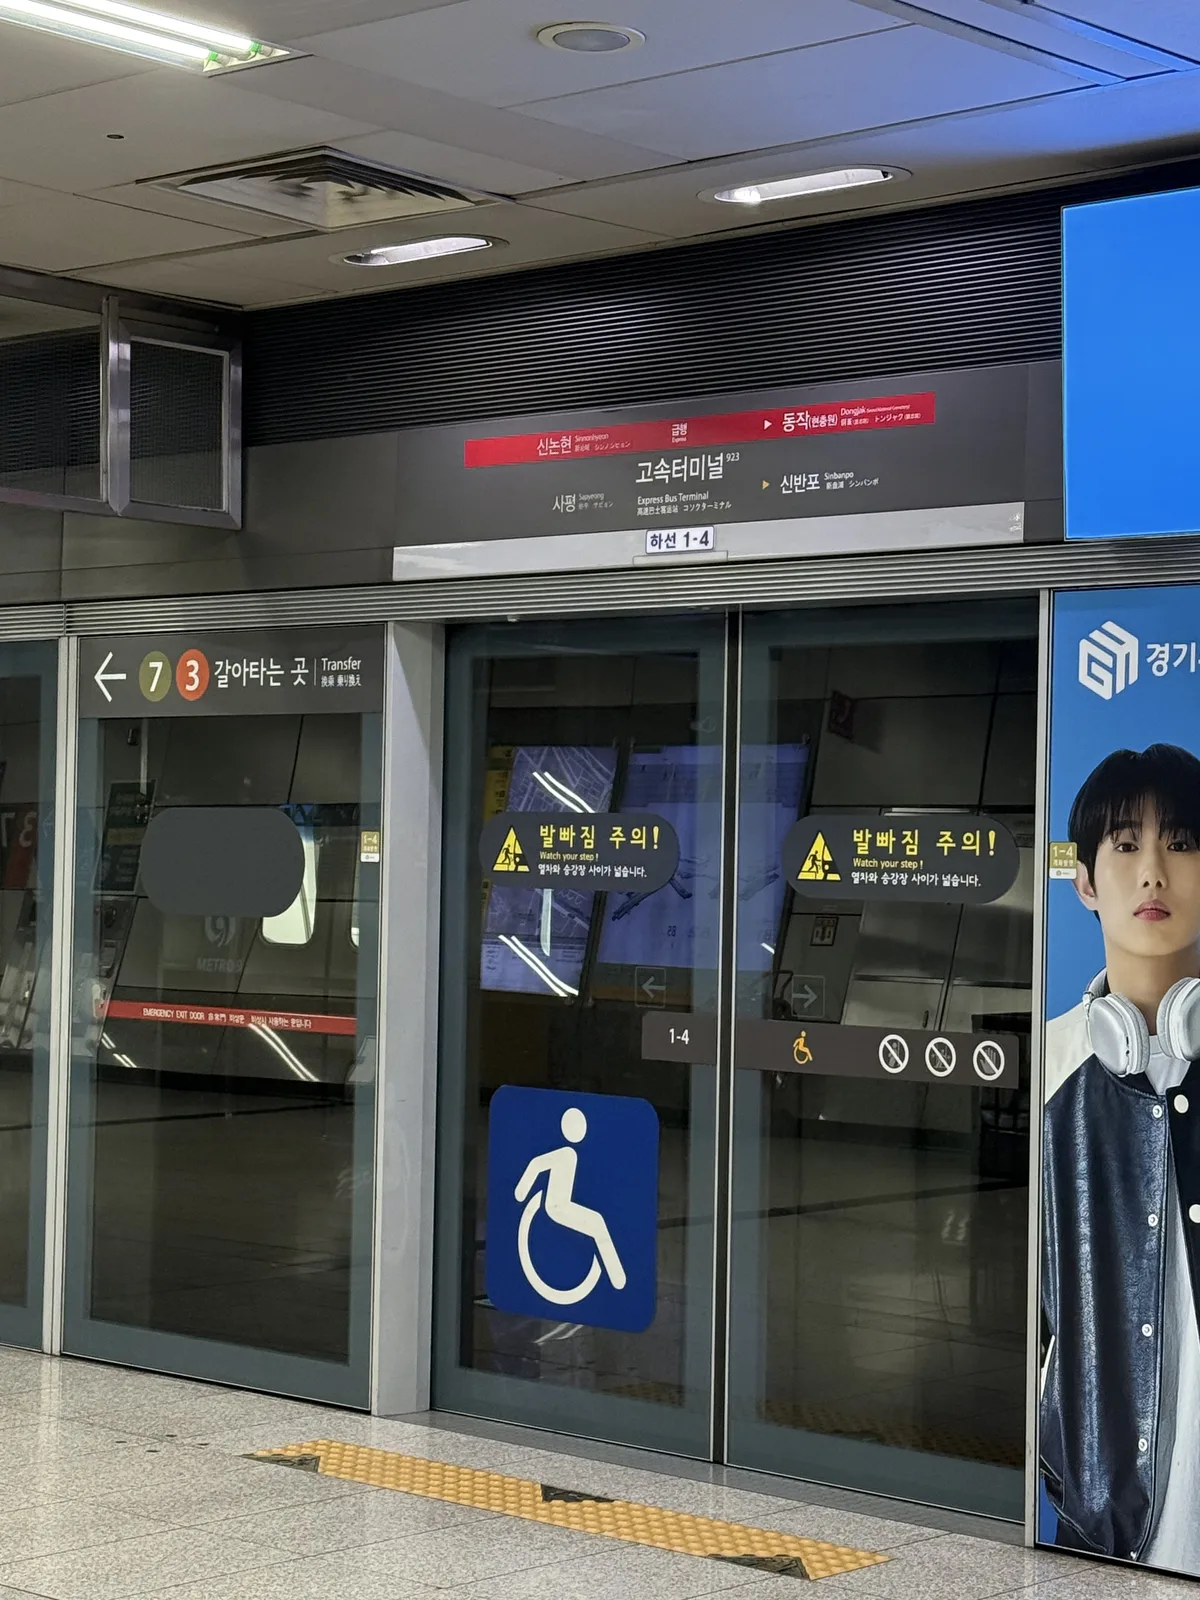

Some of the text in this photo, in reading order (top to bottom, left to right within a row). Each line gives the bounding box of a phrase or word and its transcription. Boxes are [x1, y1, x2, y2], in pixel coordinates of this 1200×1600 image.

[840, 405, 866, 417] Dongjak
[671, 422, 688, 437] 급행
[536, 435, 572, 456] 신논현
[635, 452, 740, 483] 고속터미널 923
[780, 473, 820, 494] 신반포
[823, 471, 855, 481] Sinbanpo
[552, 493, 576, 513] 사평
[579, 492, 605, 502] Sapyeong
[637, 490, 710, 507] Express Bus Terminal
[650, 530, 709, 550] 하선 1-4
[321, 656, 362, 671] Transfer
[1146, 641, 1200, 677] 경기
[149, 657, 309, 692] 7 3 갈아타는 곳
[539, 824, 660, 850] 발빠짐 주의!
[853, 828, 996, 857] 발빠짐 주의!
[539, 851, 561, 861] Watch
[562, 852, 579, 862] your
[1052, 845, 1074, 858] 1-4
[538, 864, 648, 878] 열차와 승강장 사이가 넓습니다.
[853, 858, 879, 869] Watch
[880, 859, 899, 870] your
[851, 871, 982, 887] 열차와 승강장 사이가 넓습니다.
[142, 1007, 174, 1018] EMERGENCY
[175, 1009, 188, 1019] EXIT
[189, 1011, 205, 1021] DOOR
[669, 1028, 690, 1045] 1-4
